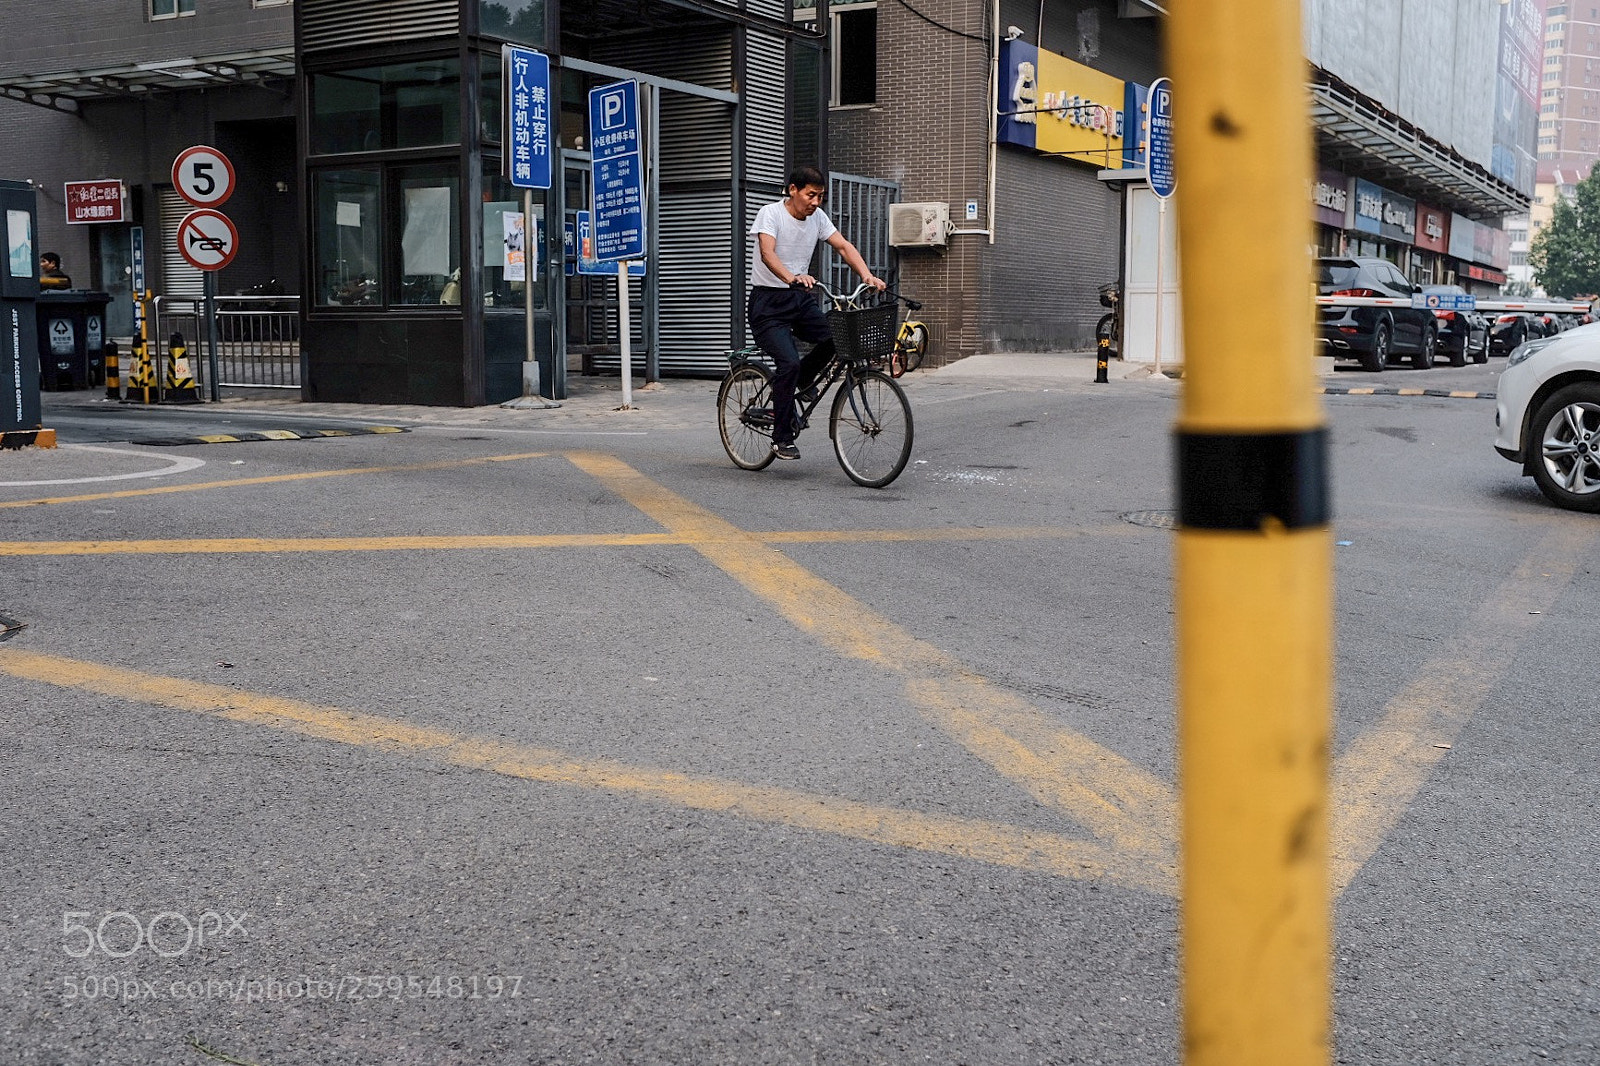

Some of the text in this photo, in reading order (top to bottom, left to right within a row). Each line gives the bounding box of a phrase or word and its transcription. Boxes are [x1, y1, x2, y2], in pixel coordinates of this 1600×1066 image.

[514, 58, 531, 180] 行人非机动车辆
[604, 95, 622, 127] P
[1159, 92, 1170, 114] P
[531, 86, 547, 156] 禁止穿行
[593, 129, 636, 148] 小区收费停车场
[192, 163, 215, 196] 5
[12, 328, 20, 359] PARKING
[13, 360, 21, 388] ACCESS
[15, 389, 23, 423] CONTROL
